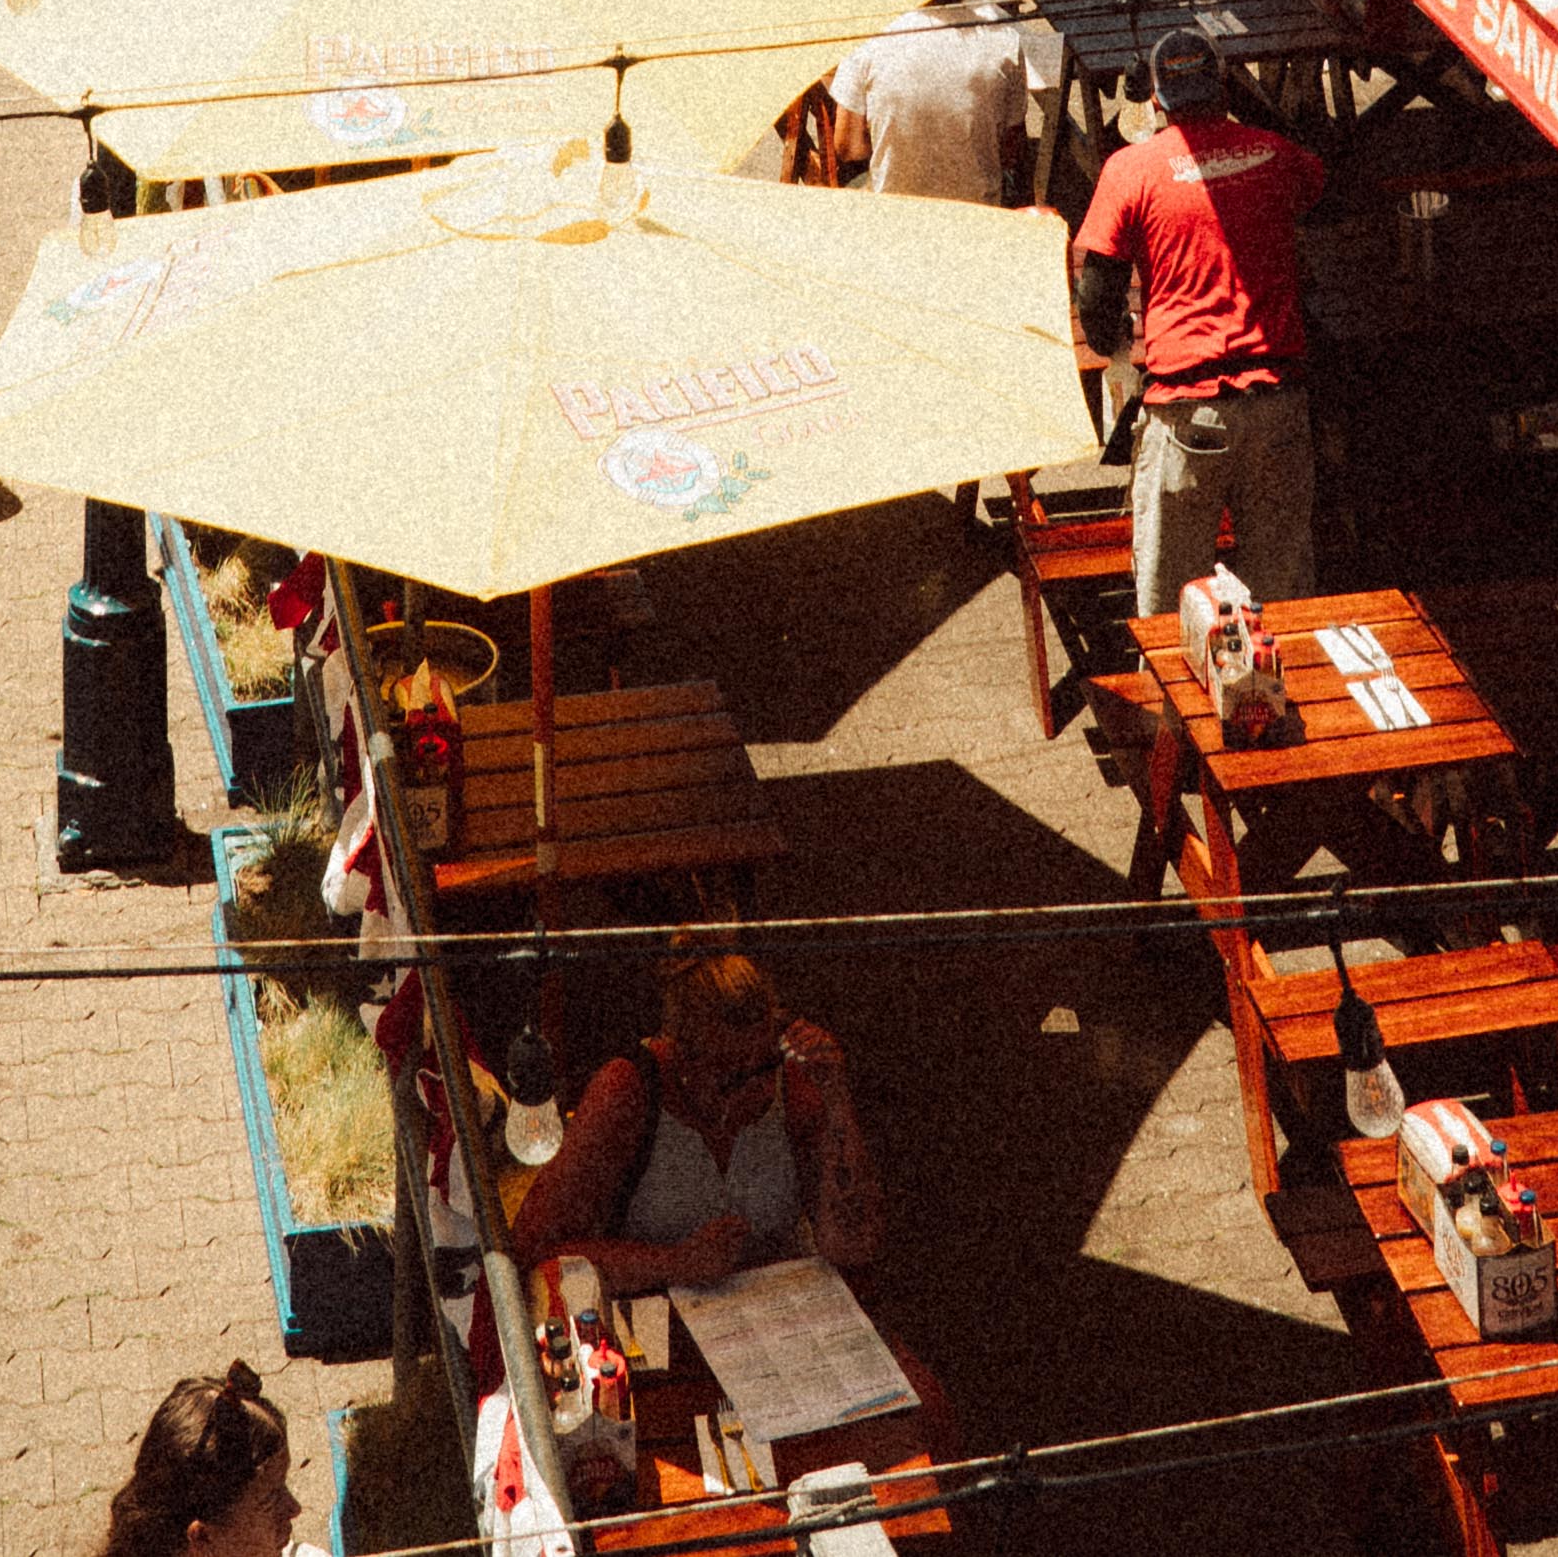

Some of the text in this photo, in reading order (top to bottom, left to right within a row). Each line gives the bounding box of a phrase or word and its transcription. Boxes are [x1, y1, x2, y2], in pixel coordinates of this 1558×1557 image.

[550, 343, 840, 442] PACIFICO
[407, 801, 442, 828] 05
[1491, 1265, 1548, 1305] 805
